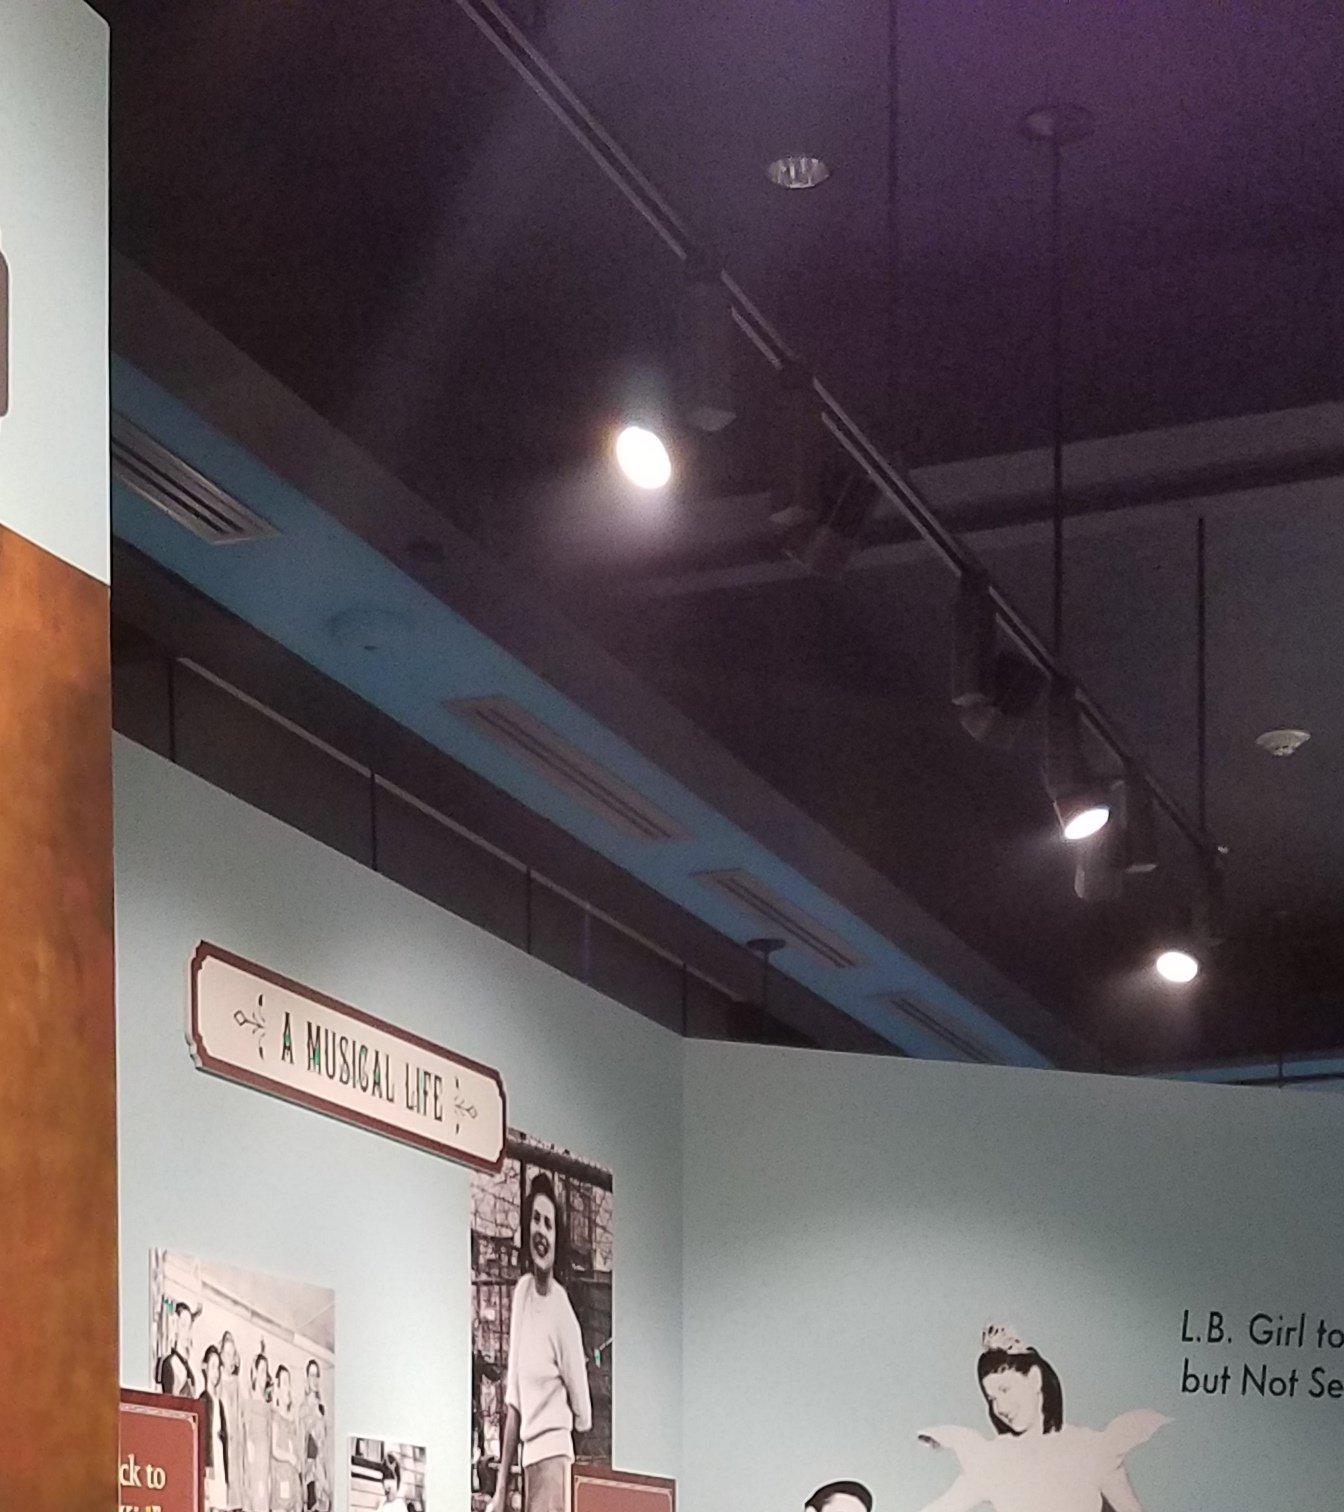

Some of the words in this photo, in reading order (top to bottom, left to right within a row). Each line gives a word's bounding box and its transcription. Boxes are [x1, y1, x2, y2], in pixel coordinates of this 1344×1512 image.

[281, 1010, 295, 1065] A
[305, 1020, 395, 1104] MUSICAL
[405, 1062, 444, 1123] LIFE
[1180, 1308, 1234, 1345] L.B.
[1248, 1312, 1307, 1348] Girl
[1180, 1357, 1233, 1396] but
[1240, 1363, 1300, 1398] Not
[146, 1464, 167, 1489] to
